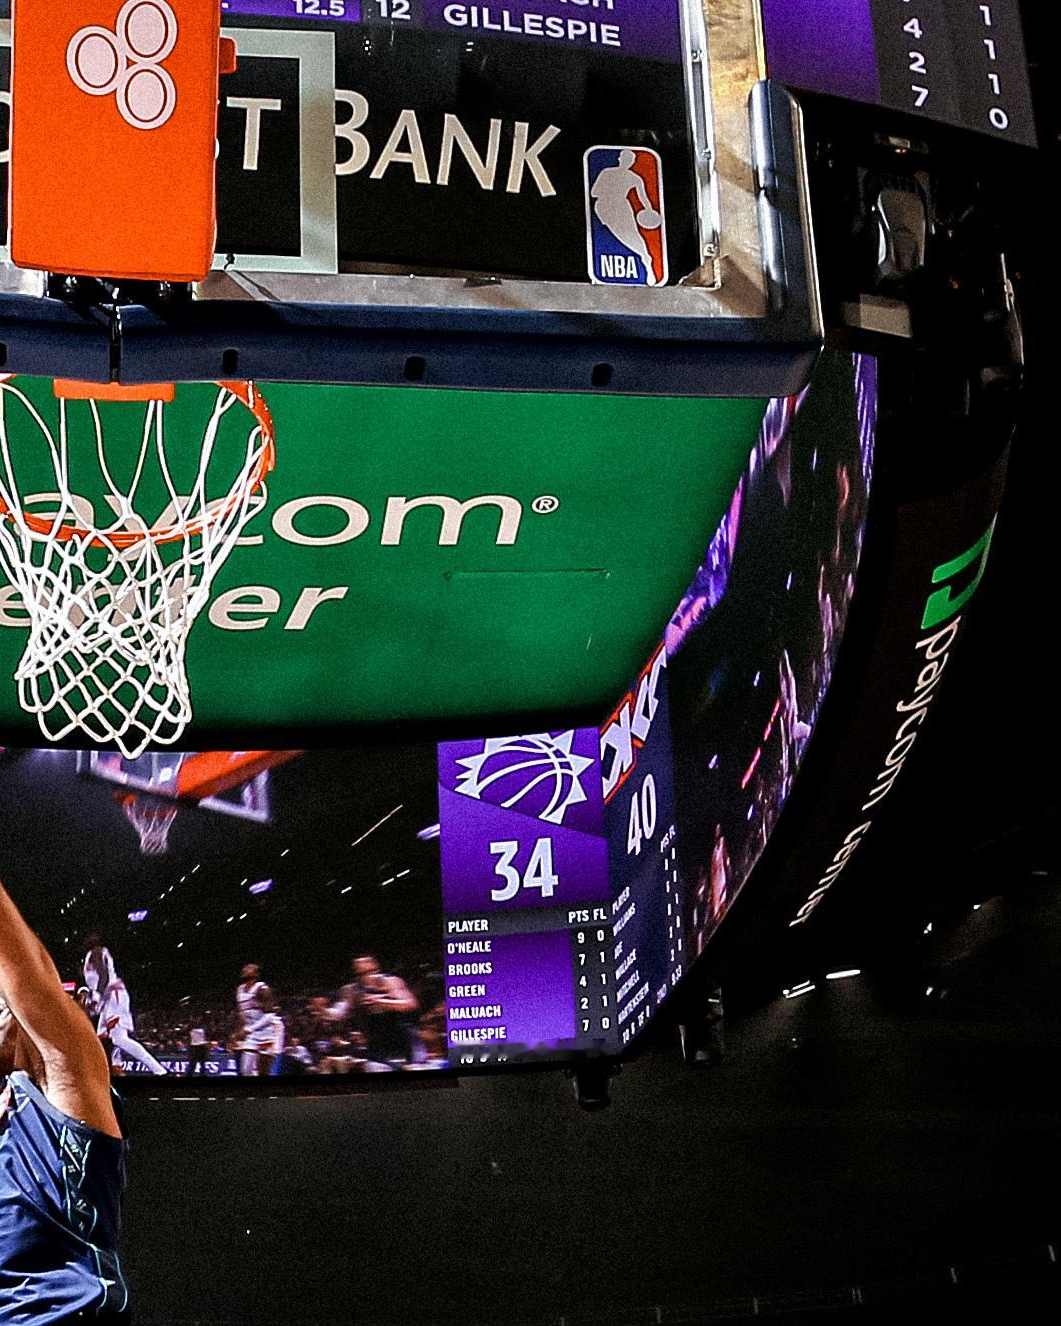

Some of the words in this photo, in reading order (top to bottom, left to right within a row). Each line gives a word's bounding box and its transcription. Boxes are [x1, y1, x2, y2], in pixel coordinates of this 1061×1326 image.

[442, 4, 622, 47] GILLESPIE
[902, 17, 924, 39] 4
[983, 38, 996, 60] 1
[908, 51, 927, 75] 2
[987, 73, 1001, 95] 1
[911, 85, 929, 107] 7
[988, 107, 1009, 130] 0
[334, 88, 561, 198] BANK
[600, 254, 639, 280] NBA
[862, 615, 963, 812] paycom
[627, 773, 658, 856] 40
[488, 837, 560, 902] 34
[447, 919, 489, 933] PLAYER
[568, 909, 589, 924] PTS
[593, 908, 608, 921] FL
[447, 940, 492, 955] O'NEALE
[577, 932, 585, 944] 9
[596, 930, 605, 942] 0
[448, 962, 493, 976] BROOKS
[578, 954, 586, 966] 7
[599, 951, 606, 963] 1
[448, 984, 486, 998] GREEN
[579, 975, 587, 987] 4
[600, 973, 607, 985] 1
[449, 1005, 502, 1020] MALUACH
[580, 997, 589, 1010] 2
[602, 995, 608, 1007] 1
[450, 1026, 507, 1042] GILLESPIE
[582, 1019, 590, 1032] 7
[601, 1017, 610, 1029] 0
